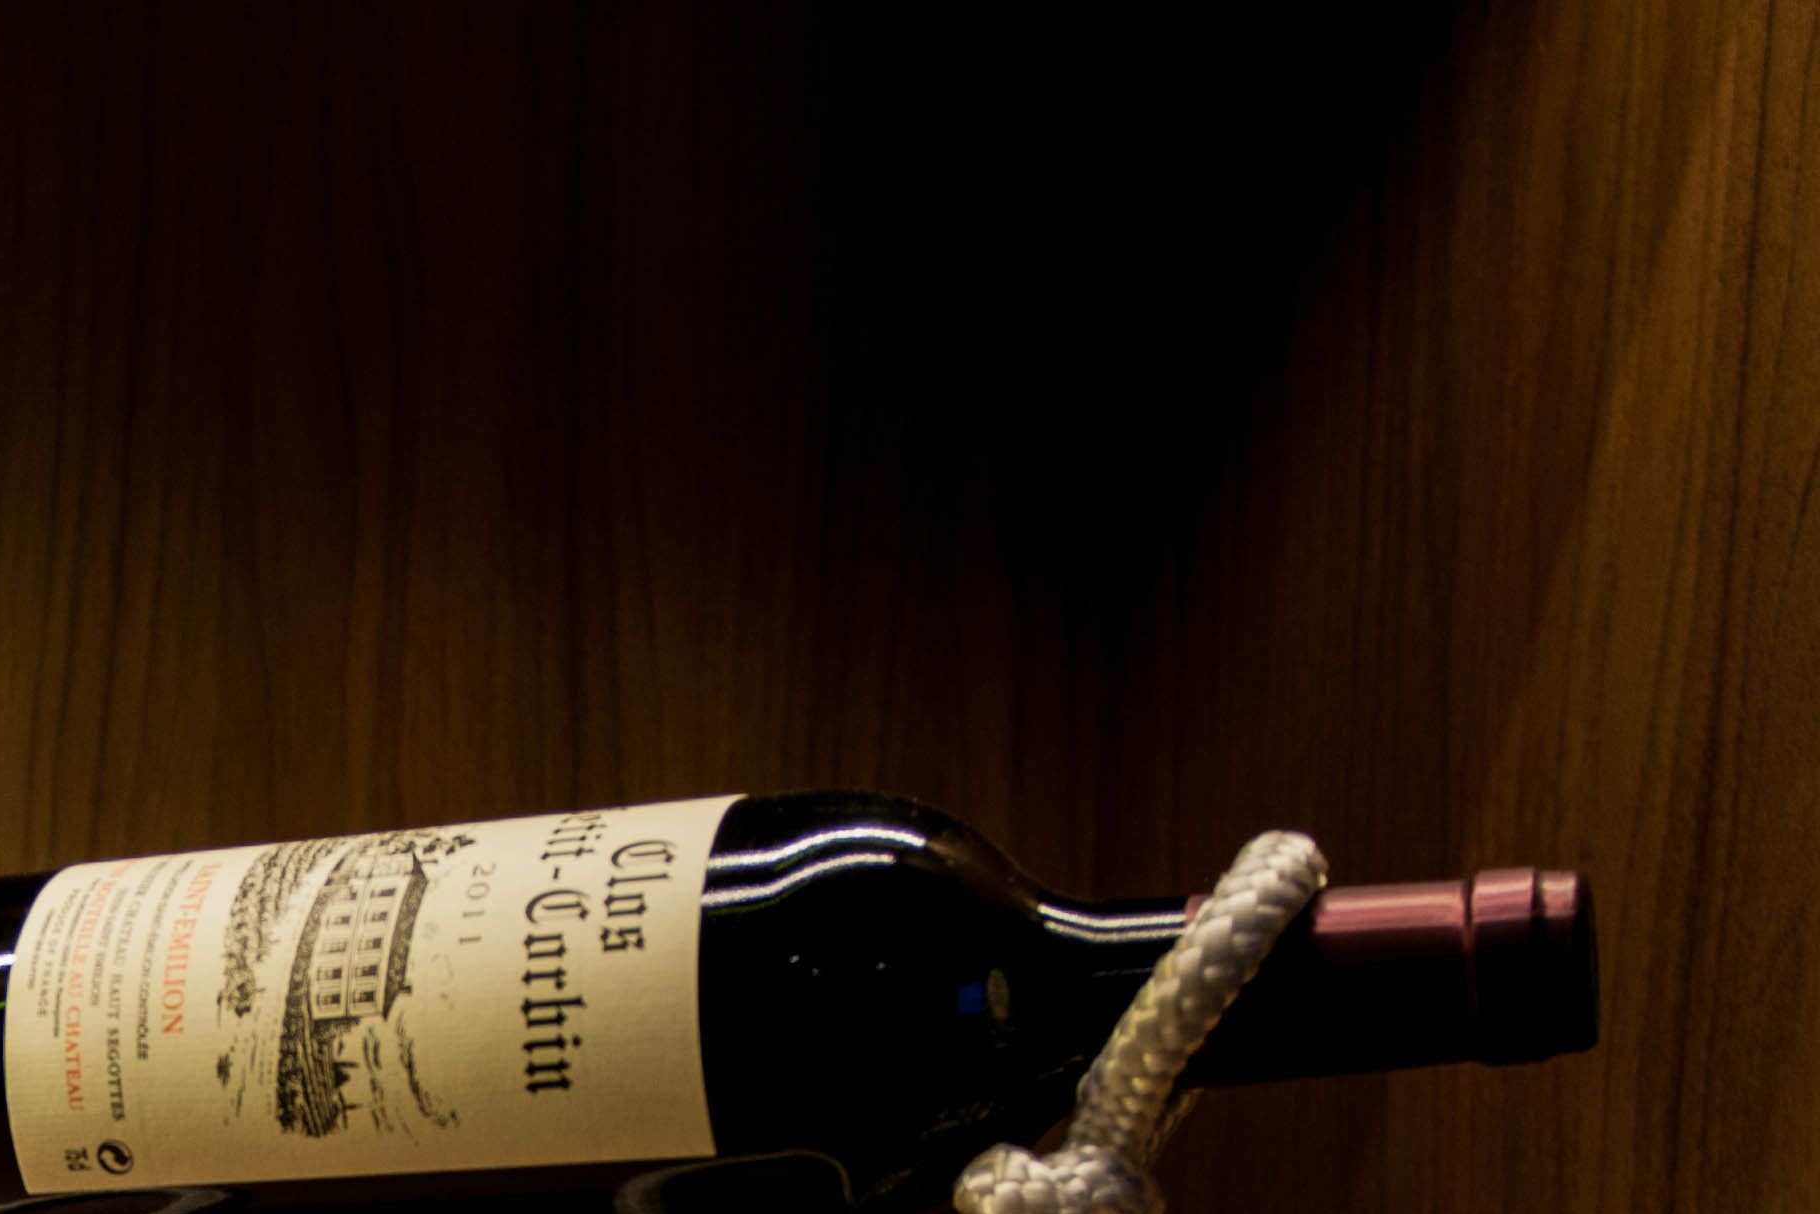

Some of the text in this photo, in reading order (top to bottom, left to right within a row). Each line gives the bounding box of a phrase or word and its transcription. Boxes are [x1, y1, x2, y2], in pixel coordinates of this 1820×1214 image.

[459, 861, 498, 946] 2011
[601, 838, 682, 954] Clos
[67, 972, 85, 998] AU
[107, 974, 123, 1020] HAUT
[521, 809, 610, 1094] etit-Corbin
[65, 1005, 85, 1112] CHATEAU
[107, 1027, 126, 1121] SEGOTTES
